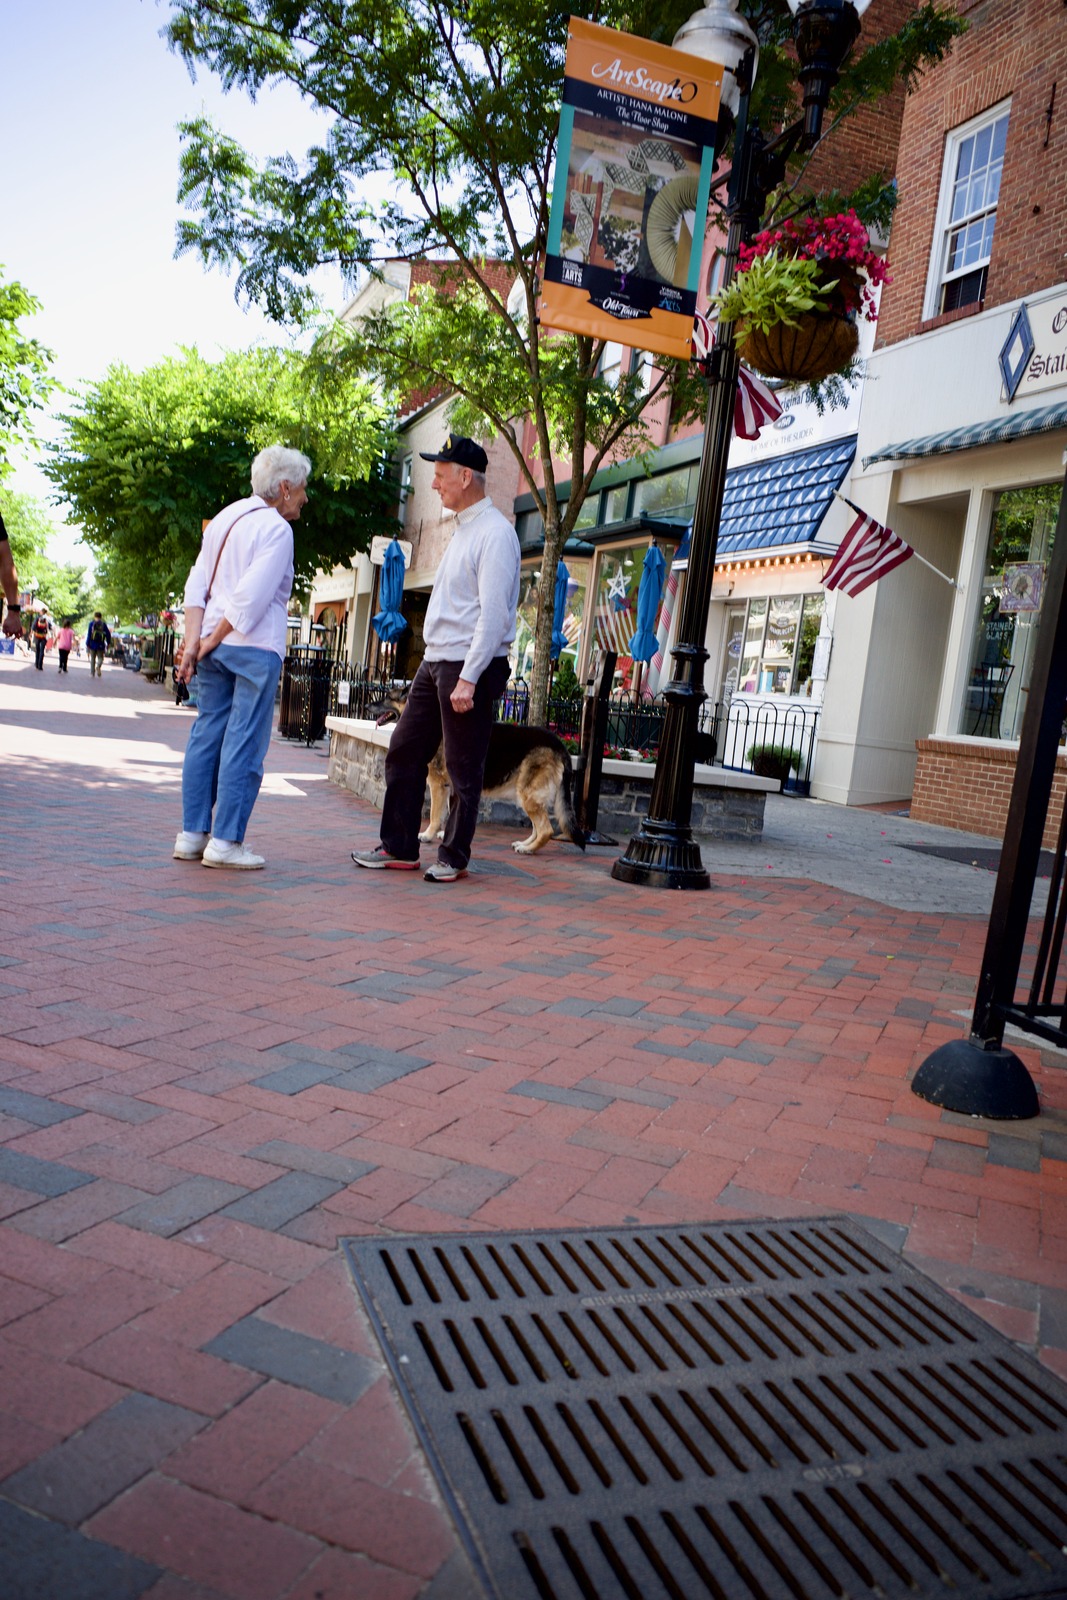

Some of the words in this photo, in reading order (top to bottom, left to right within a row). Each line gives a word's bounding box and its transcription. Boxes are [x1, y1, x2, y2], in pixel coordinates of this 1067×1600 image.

[591, 58, 682, 102] ArtScape
[597, 89, 628, 105] ARTIST:
[629, 98, 652, 113] HANA
[653, 106, 688, 124] MALONE
[616, 105, 630, 119] The
[631, 110, 651, 125] Floor
[651, 116, 669, 133] Shop
[565, 268, 583, 283] ARTS
[602, 297, 620, 311] Old
[617, 302, 639, 318] Town
[658, 297, 680, 312] Arts
[780, 390, 806, 411] riginal
[780, 433, 792, 444] THE
[793, 427, 814, 442] SLIDER
[986, 621, 1013, 631] STAINED
[986, 631, 1009, 640] GLASS
